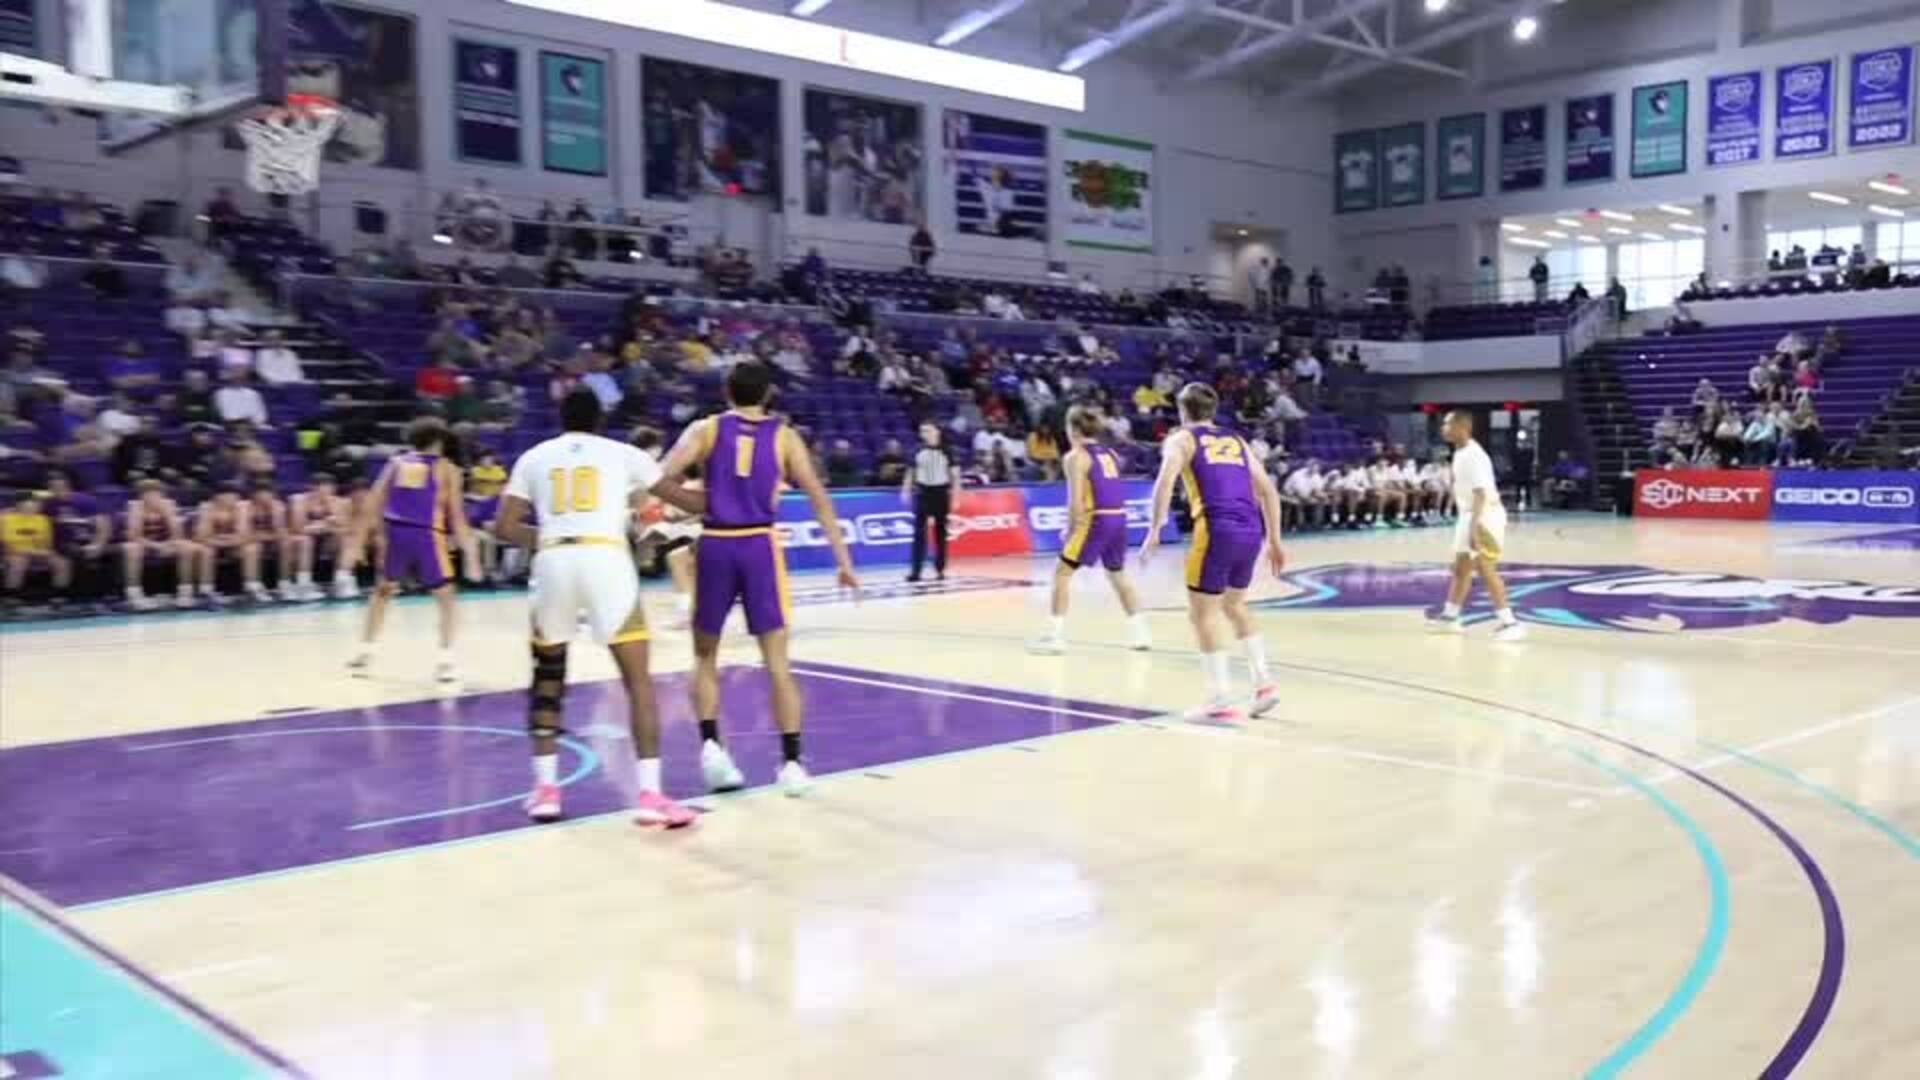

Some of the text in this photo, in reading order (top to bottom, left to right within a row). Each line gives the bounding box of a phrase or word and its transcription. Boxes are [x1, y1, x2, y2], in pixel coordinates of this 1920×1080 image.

[1855, 123, 1901, 142] 2022
[1781, 135, 1821, 153] 2021
[1200, 434, 1246, 466] 22
[550, 464, 598, 514] 10
[1775, 488, 1861, 505] GEICO
